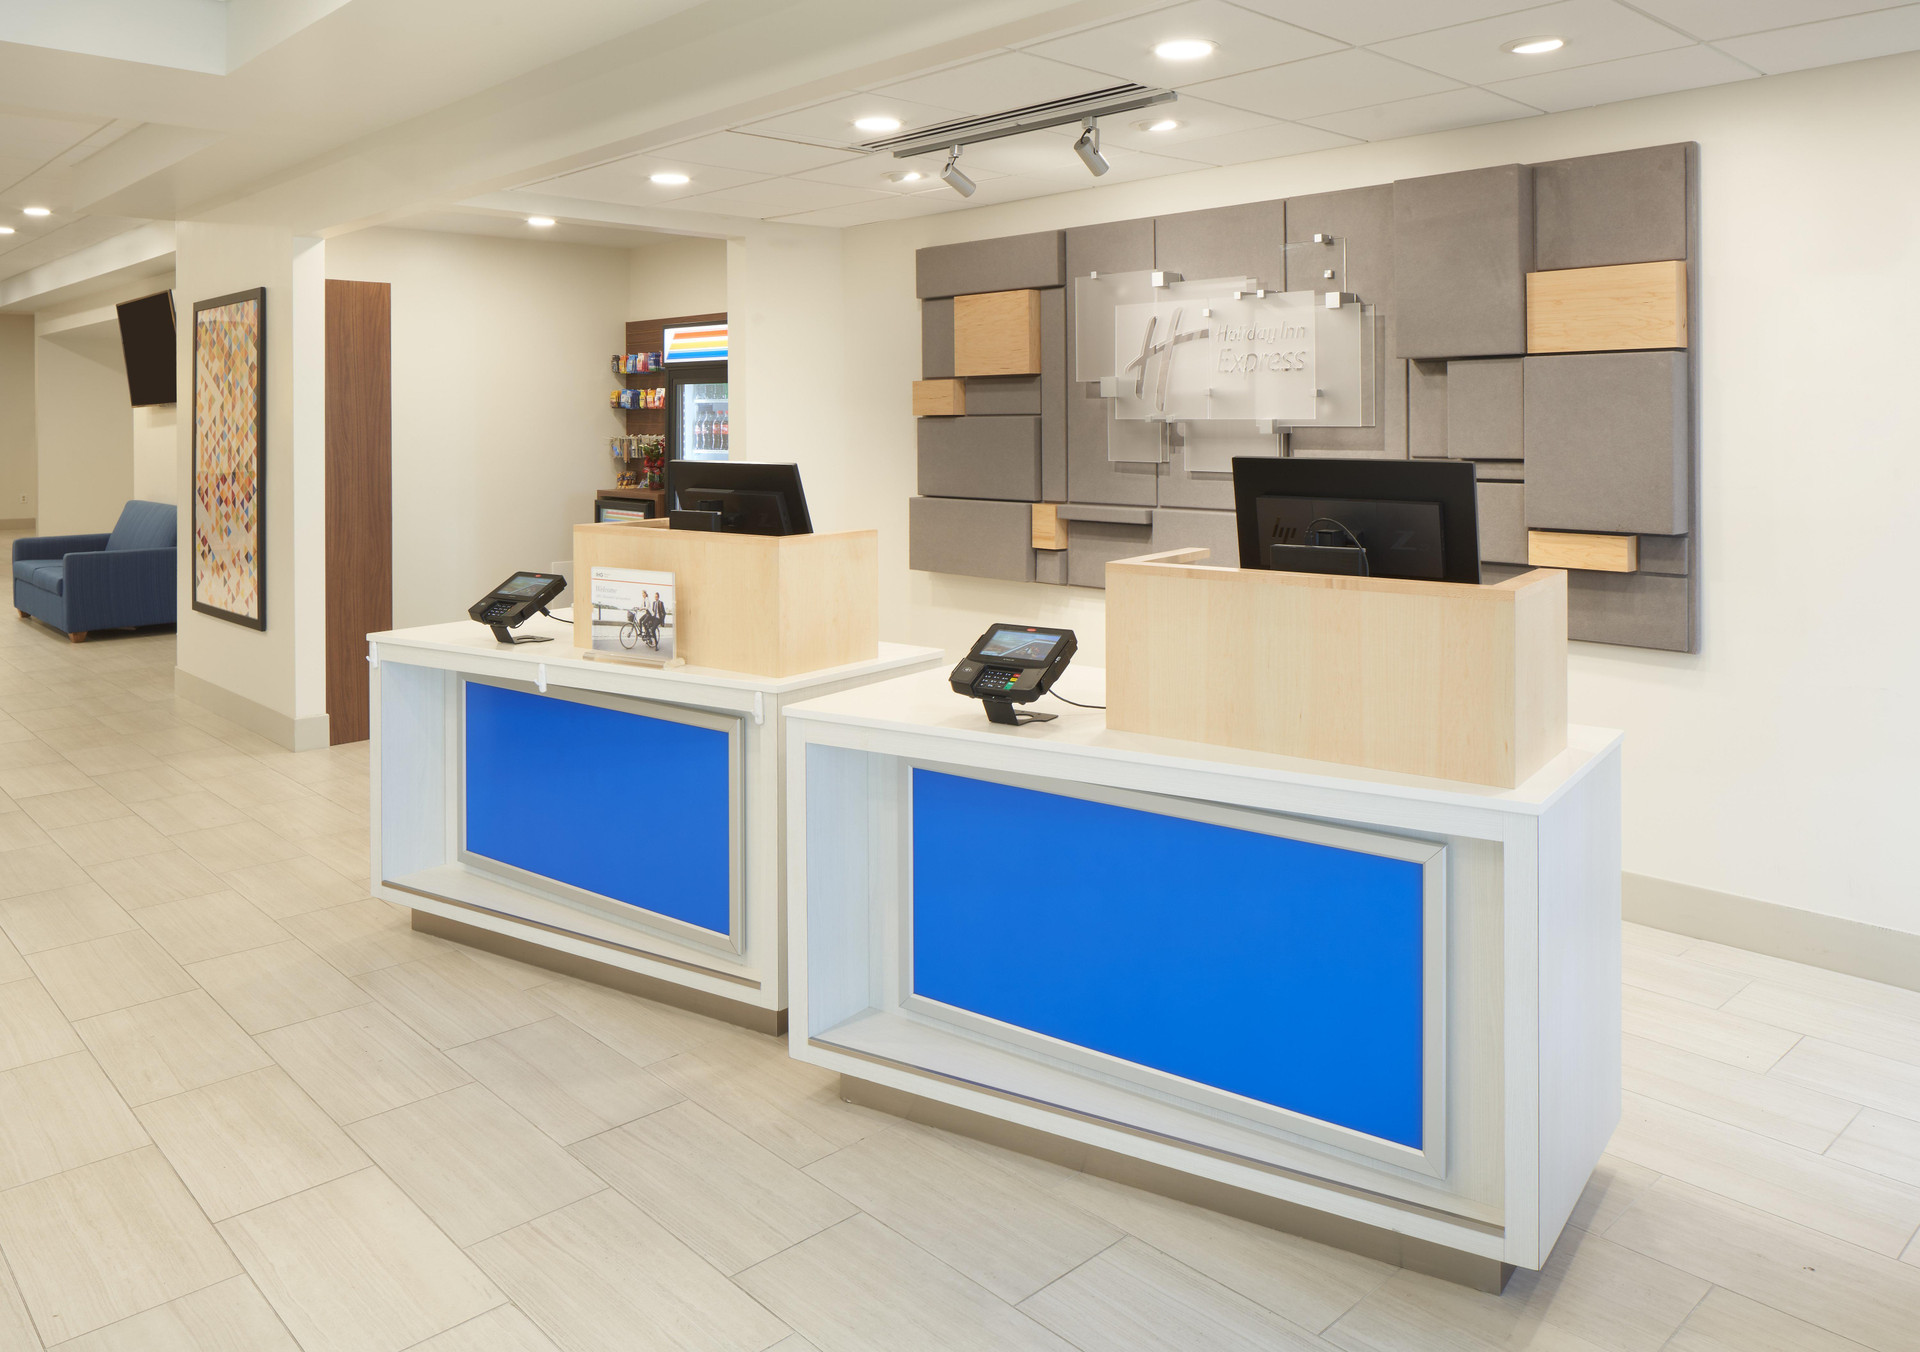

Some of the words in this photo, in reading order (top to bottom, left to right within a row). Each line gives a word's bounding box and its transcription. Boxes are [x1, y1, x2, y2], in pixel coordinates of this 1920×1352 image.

[1216, 320, 1277, 344] Holiday
[1280, 319, 1306, 340] Inn
[1217, 348, 1306, 379] Express
